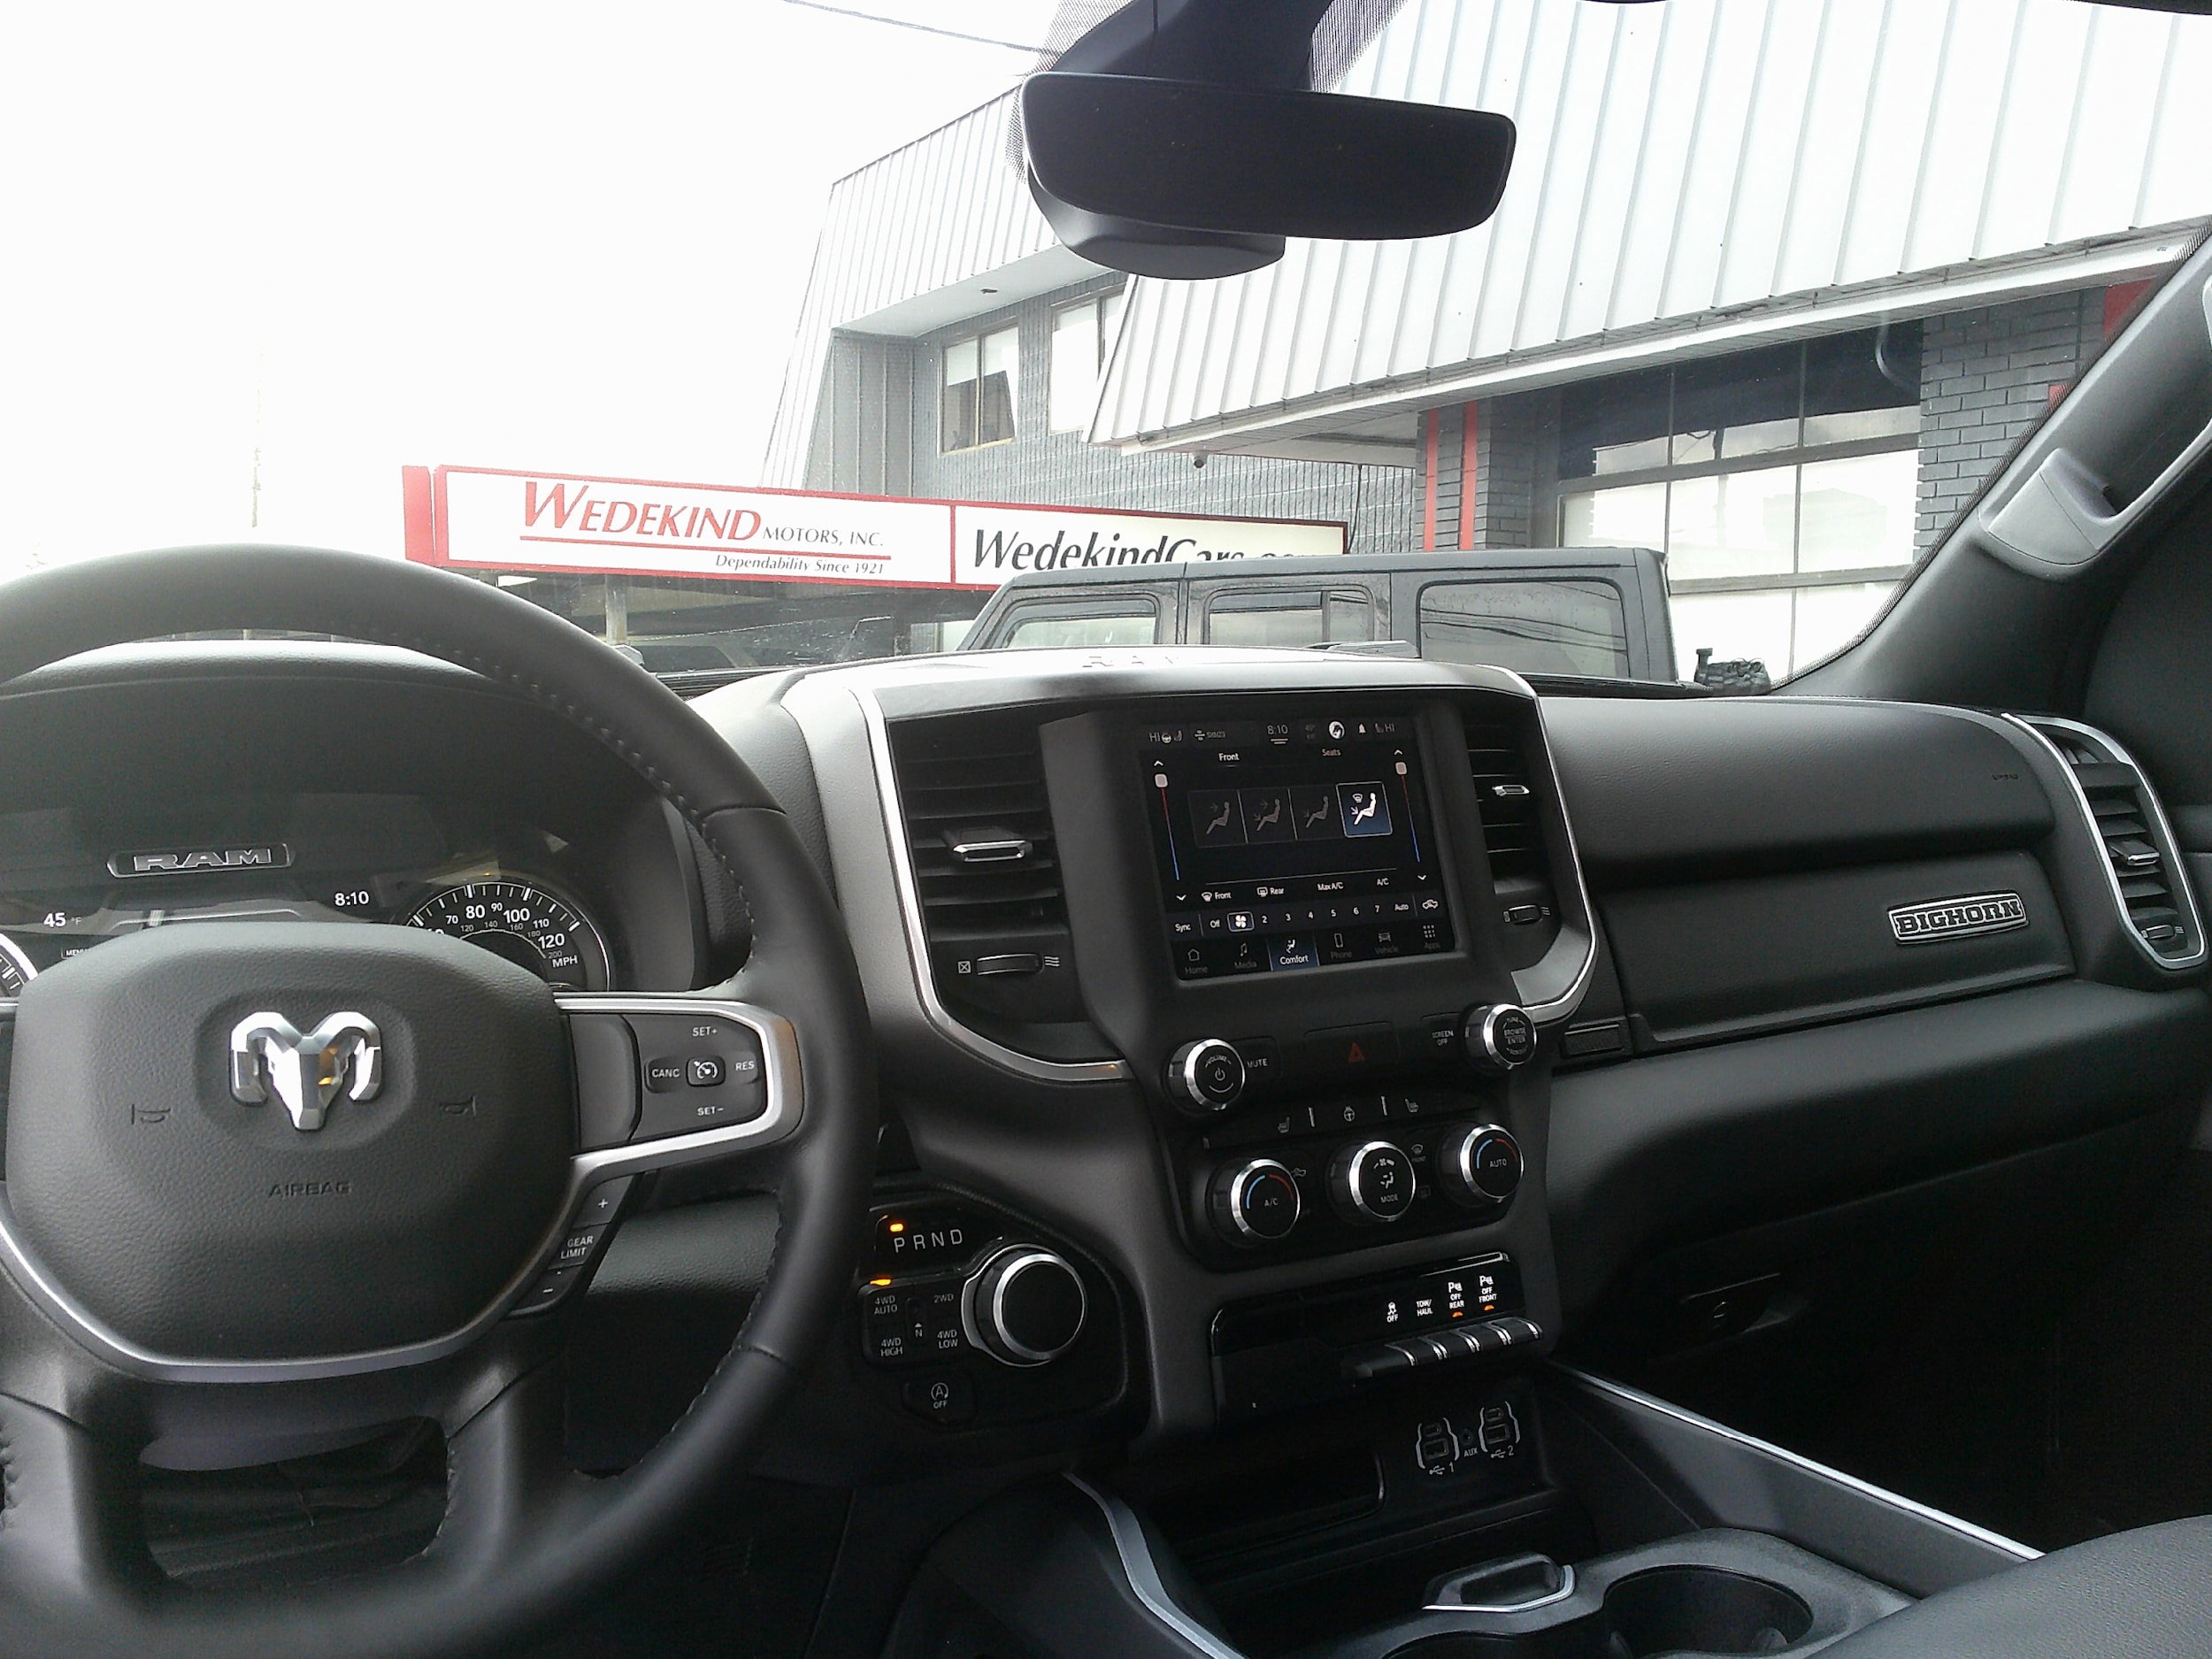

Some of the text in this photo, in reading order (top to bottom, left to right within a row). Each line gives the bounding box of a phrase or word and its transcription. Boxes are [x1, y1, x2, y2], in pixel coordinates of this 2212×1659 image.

[525, 481, 884, 547] WEDEKIND MOTORS, INC.
[716, 554, 884, 574] Dependability Since 1921
[1267, 725, 1289, 735] 8:10
[1218, 752, 1240, 762] Front
[1321, 748, 1342, 757] Seats
[134, 849, 272, 872] RAM
[1376, 878, 1390, 887] A/C
[1214, 892, 1232, 901] Front
[1270, 887, 1285, 897] Rear
[334, 890, 370, 907] 8:10
[465, 904, 486, 919] 80
[490, 902, 503, 913] 90
[1353, 906, 1360, 916] 6
[1374, 903, 1381, 913] 7
[503, 908, 531, 924] 100
[1285, 912, 1292, 922] 3
[1307, 910, 1315, 920] 4
[1331, 909, 1338, 918] 5
[1895, 901, 2022, 936] BIGHORN
[43, 912, 66, 927] 45
[445, 915, 459, 926] 70
[484, 920, 499, 930] 140
[533, 918, 550, 930] 110
[1261, 914, 1269, 925] 2
[460, 924, 474, 933] 120
[509, 923, 524, 932] 160
[1174, 922, 1192, 933] Sync
[538, 933, 566, 949] 120
[551, 955, 579, 968] MPH
[1279, 953, 1310, 965] Comfort
[735, 1062, 756, 1072] RES
[1247, 1057, 1268, 1069] MUTE
[651, 1068, 680, 1079] CANC
[1489, 1158, 1508, 1169] AUTO
[269, 1182, 350, 1196] AIRBAG
[1264, 1197, 1279, 1207] A/C
[566, 1235, 594, 1248] GEAR
[894, 1229, 964, 1253] P R N D
[560, 1247, 587, 1259] LIMIT
[875, 1294, 895, 1305] 4WD
[933, 1293, 955, 1303] 2WD
[1450, 1293, 1462, 1302] OFF
[1479, 1293, 1498, 1303] FRONT
[873, 1303, 898, 1315] AUTO
[1448, 1300, 1464, 1310] REAR
[1417, 1308, 1433, 1317] HAUL
[1386, 1314, 1399, 1323] OFF
[915, 1328, 923, 1338] N
[937, 1329, 958, 1340] 4WD
[881, 1337, 902, 1348] 4WD
[938, 1339, 958, 1349] LOW
[880, 1347, 903, 1357] HIGH
[1463, 1447, 1478, 1458] AUX
[1508, 1445, 1515, 1456] 2
[1449, 1461, 1455, 1473] 1
